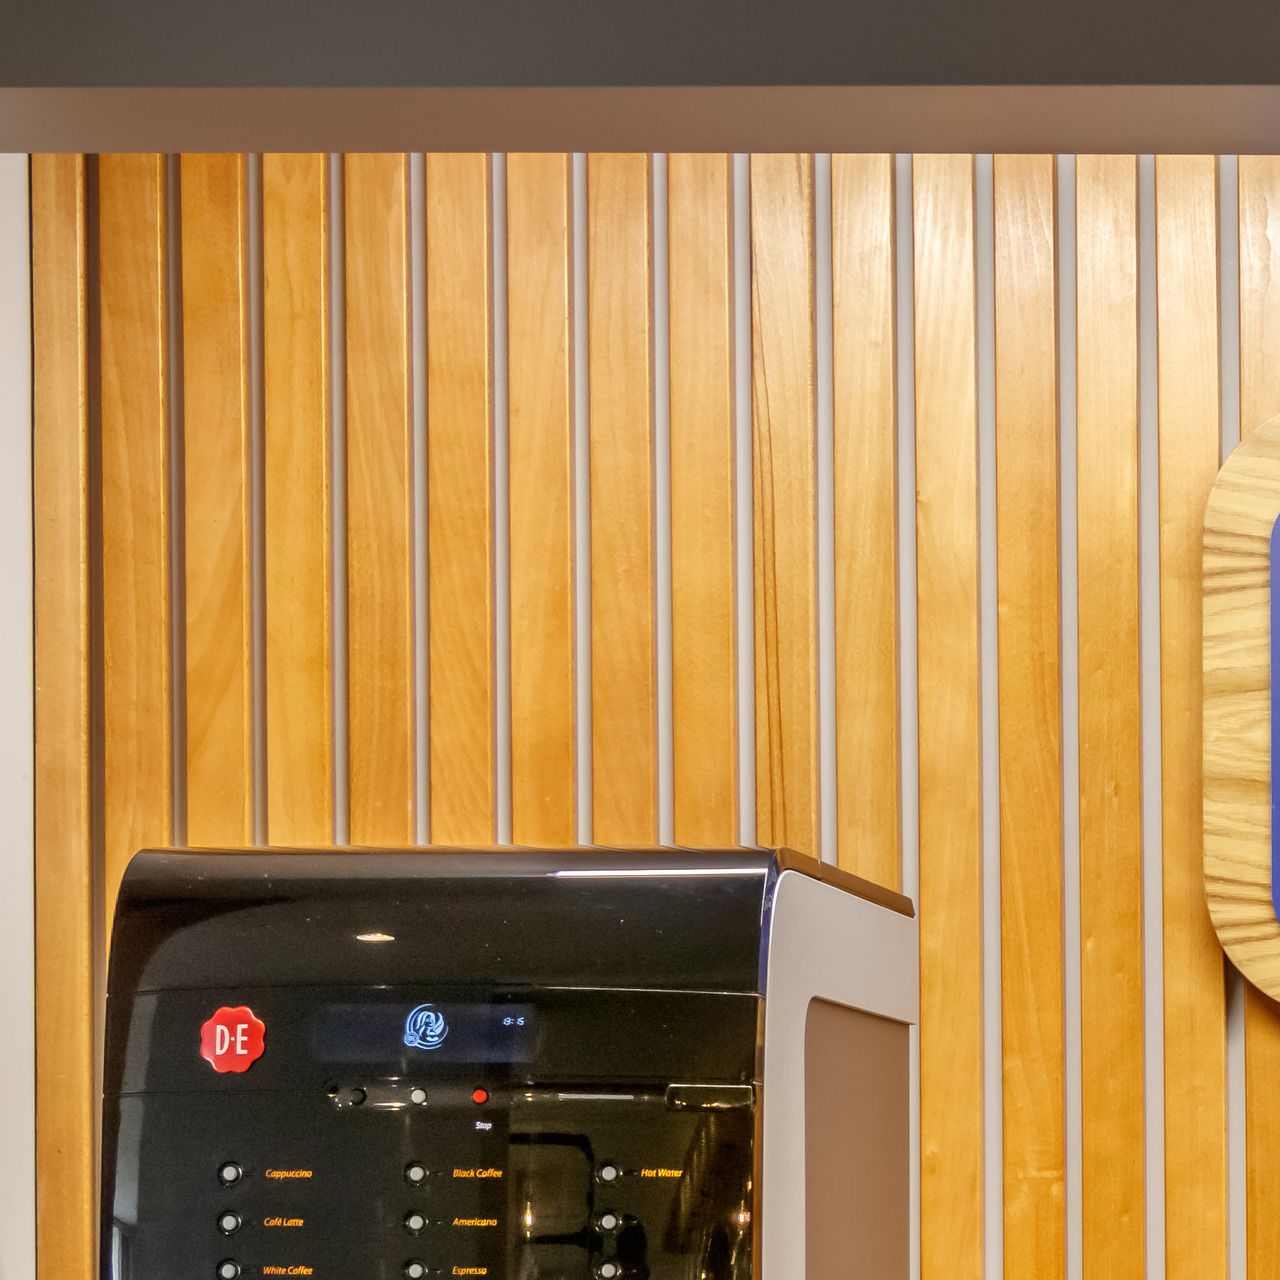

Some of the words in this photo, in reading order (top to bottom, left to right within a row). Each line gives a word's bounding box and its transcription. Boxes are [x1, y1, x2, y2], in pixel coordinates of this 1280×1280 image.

[475, 1121, 493, 1131] Stop
[265, 1168, 313, 1180] Cappuccino
[452, 1168, 475, 1178] Black
[476, 1168, 503, 1178] Coffee
[641, 1168, 656, 1178] Hot
[657, 1168, 683, 1178] Water
[283, 1218, 304, 1227] Latte
[452, 1217, 498, 1227] Americano
[262, 1265, 287, 1275] White
[287, 1265, 313, 1275] Coffee
[451, 1266, 488, 1277] Espresso
